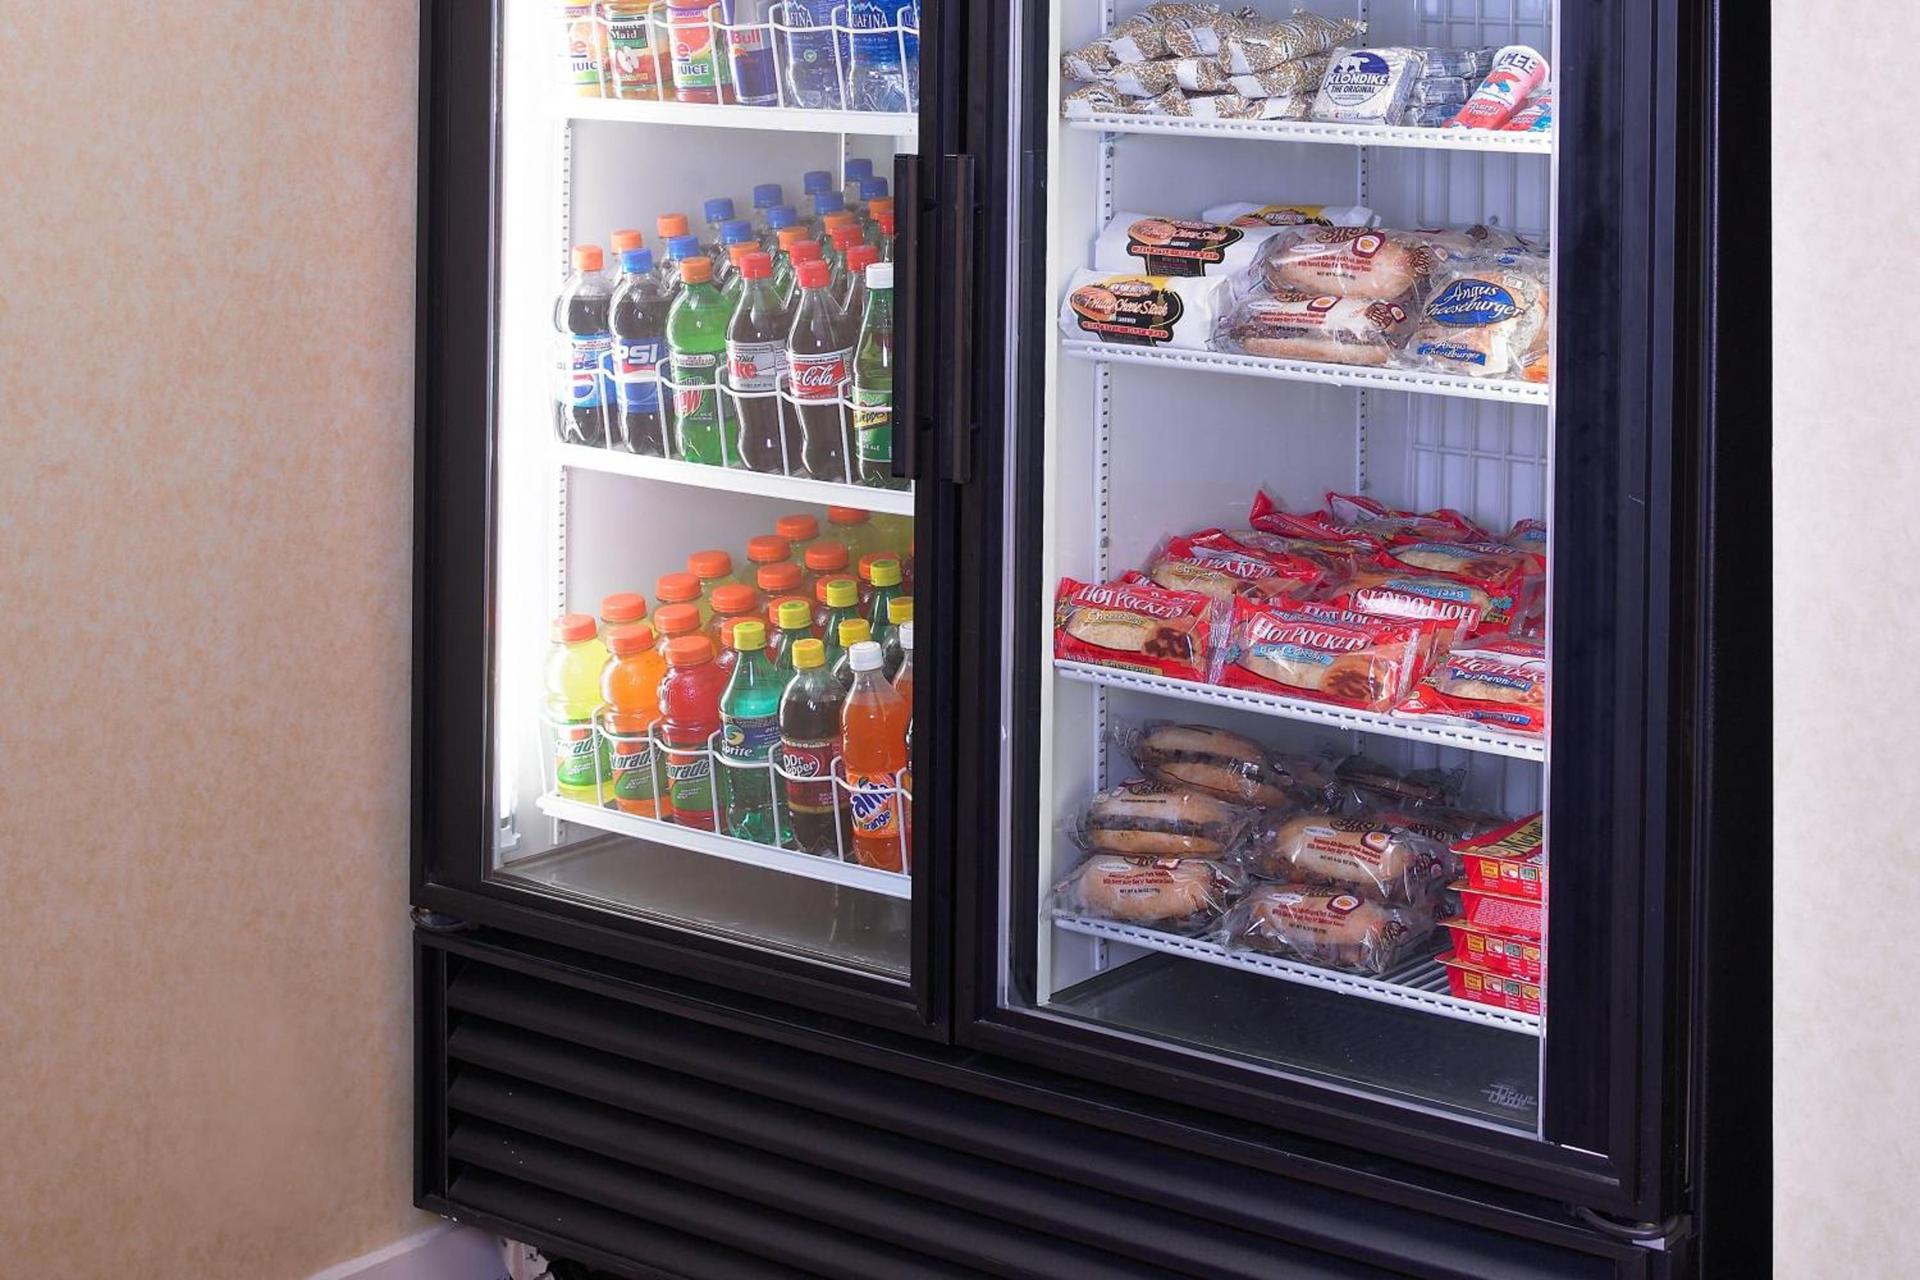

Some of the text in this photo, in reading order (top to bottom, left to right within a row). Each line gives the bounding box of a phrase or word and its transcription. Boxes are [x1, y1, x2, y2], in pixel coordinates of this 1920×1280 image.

[732, 29, 760, 44] Bull
[572, 60, 600, 72] JUIC
[678, 64, 708, 75] JUICE
[1325, 73, 1389, 87] KLONDIKE
[1331, 85, 1375, 94] THE ORIGINAL
[1444, 282, 1500, 302] Angus
[1078, 586, 1183, 618] HOT POCKETS
[1253, 617, 1366, 650] HOT POCKETS
[722, 740, 752, 757] Sprite
